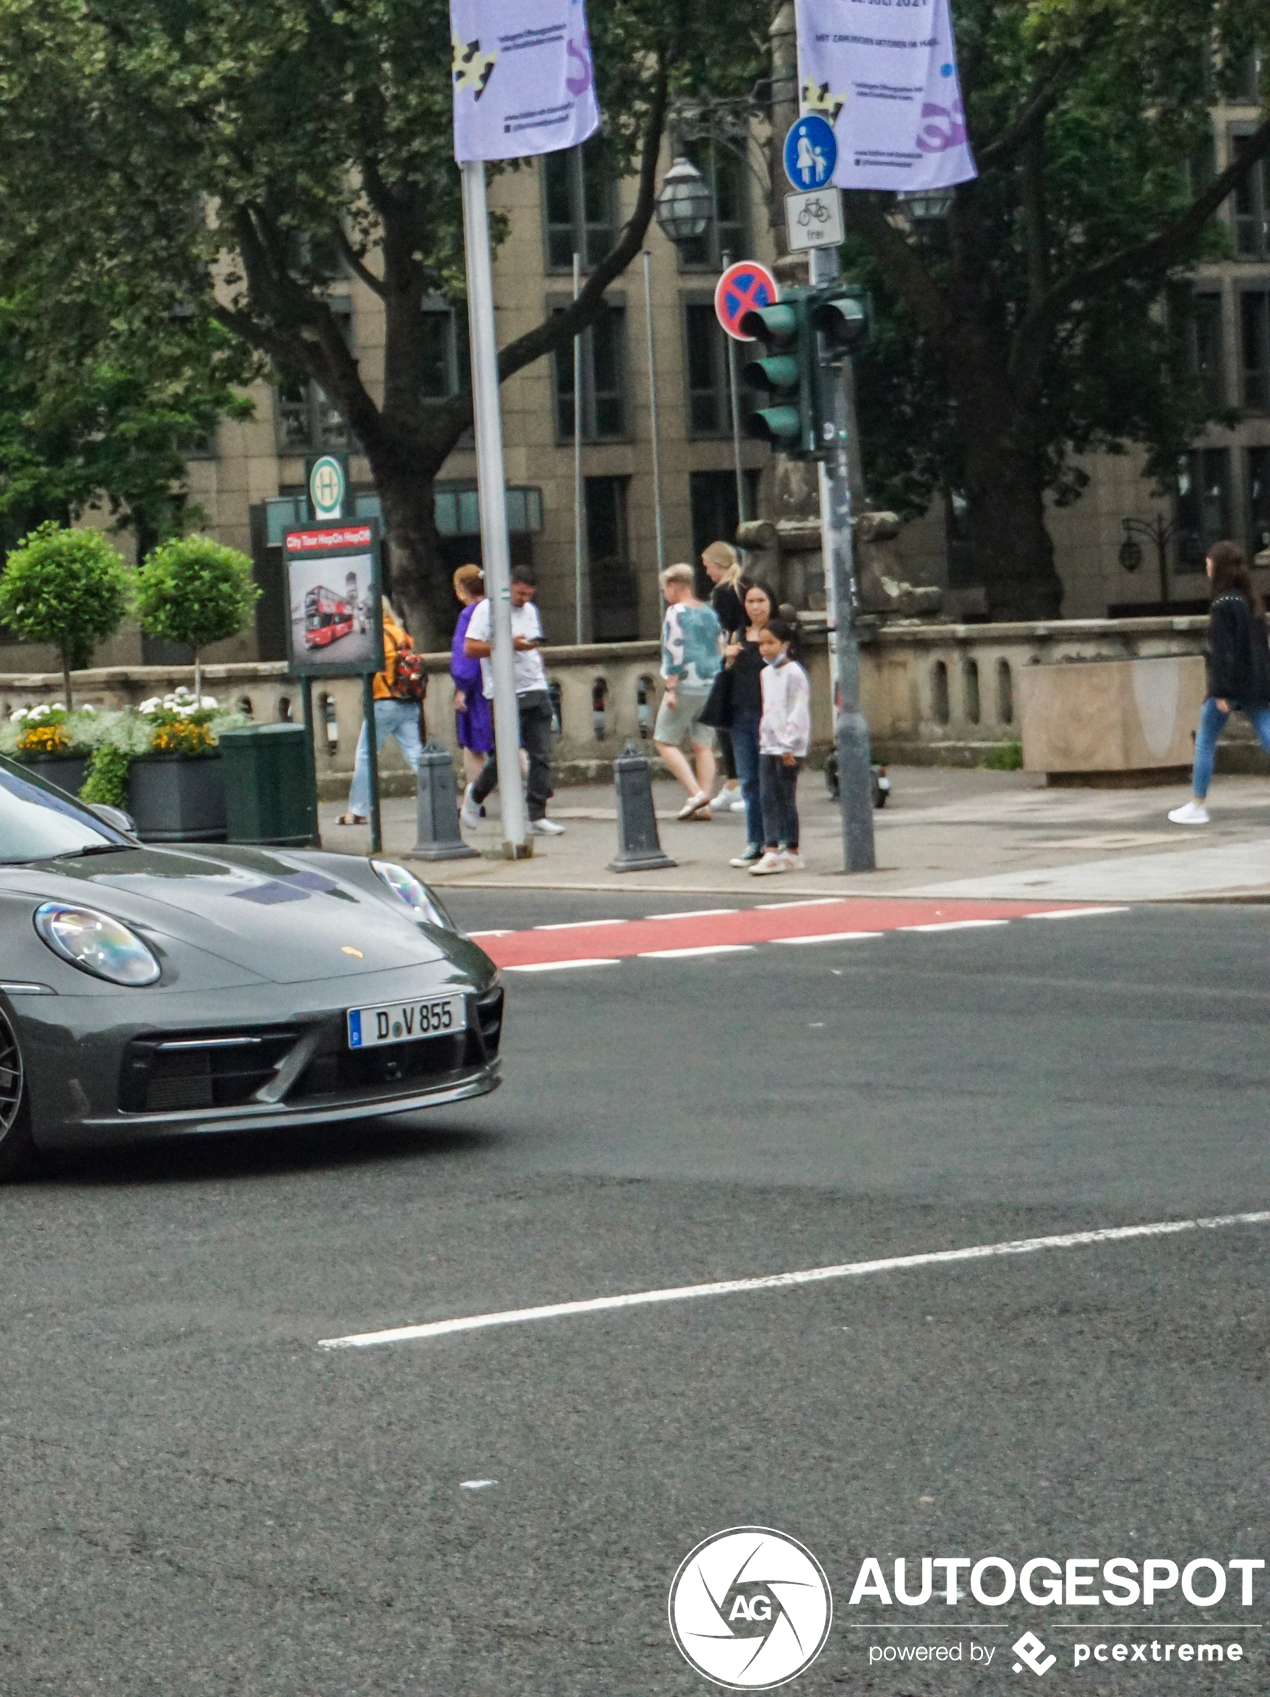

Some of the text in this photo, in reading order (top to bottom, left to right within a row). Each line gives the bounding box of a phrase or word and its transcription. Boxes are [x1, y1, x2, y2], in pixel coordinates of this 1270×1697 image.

[319, 470, 333, 502] H
[376, 1001, 452, 1040] D V 855
